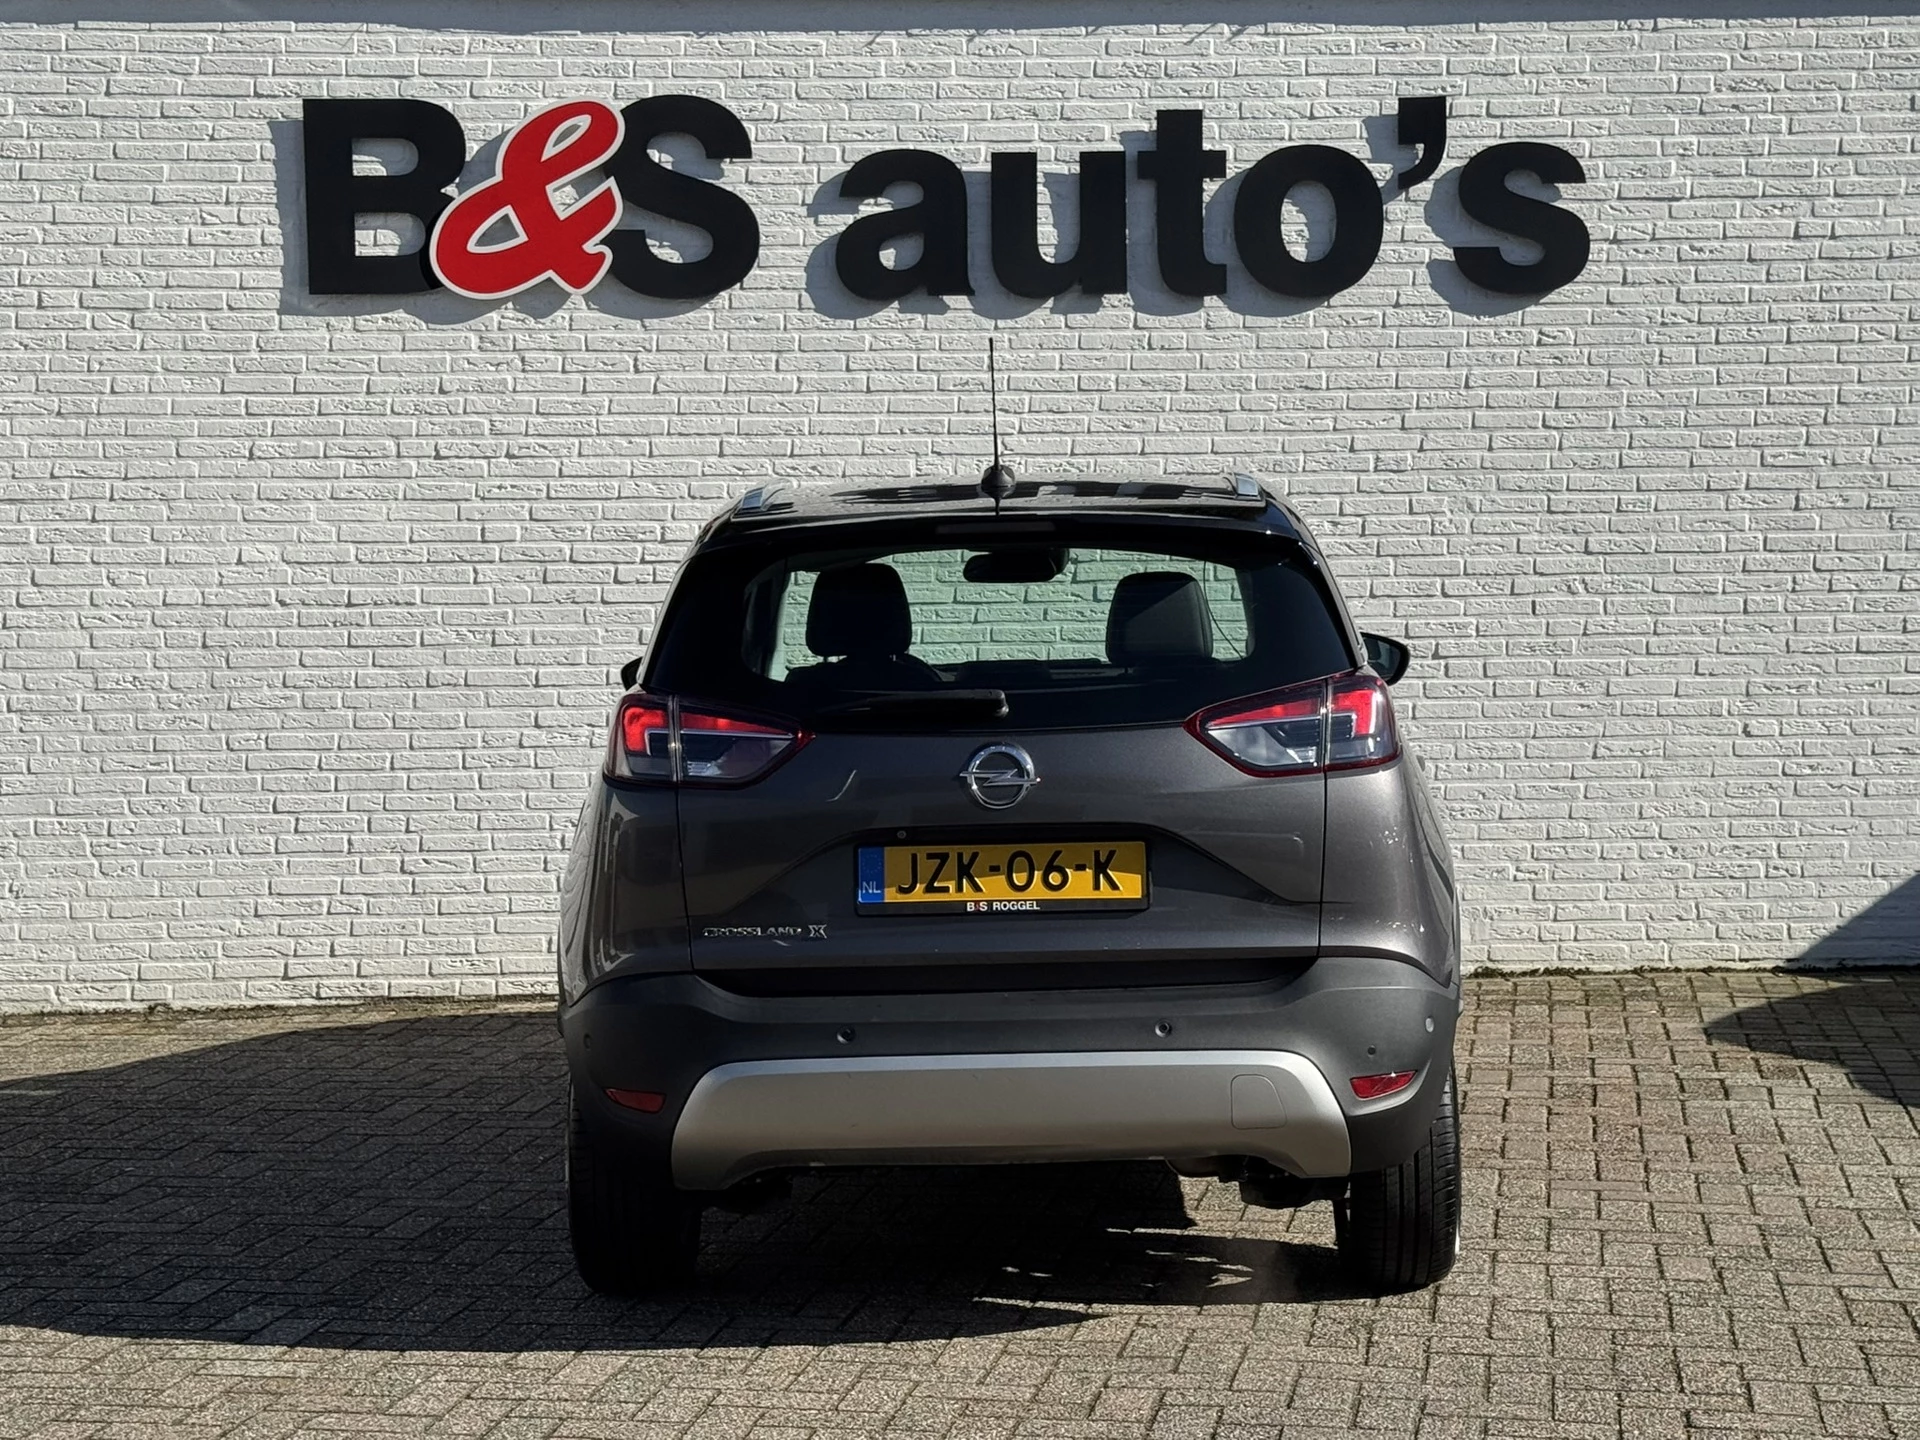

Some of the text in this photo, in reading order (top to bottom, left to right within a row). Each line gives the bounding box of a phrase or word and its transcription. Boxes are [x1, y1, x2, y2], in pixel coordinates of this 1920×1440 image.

[302, 94, 1590, 301] B&S auto's
[896, 849, 1124, 894] JZK-06-K
[862, 882, 882, 894] NL
[992, 900, 1040, 911] ROGGEL
[702, 924, 828, 939] CROSSLAND X
